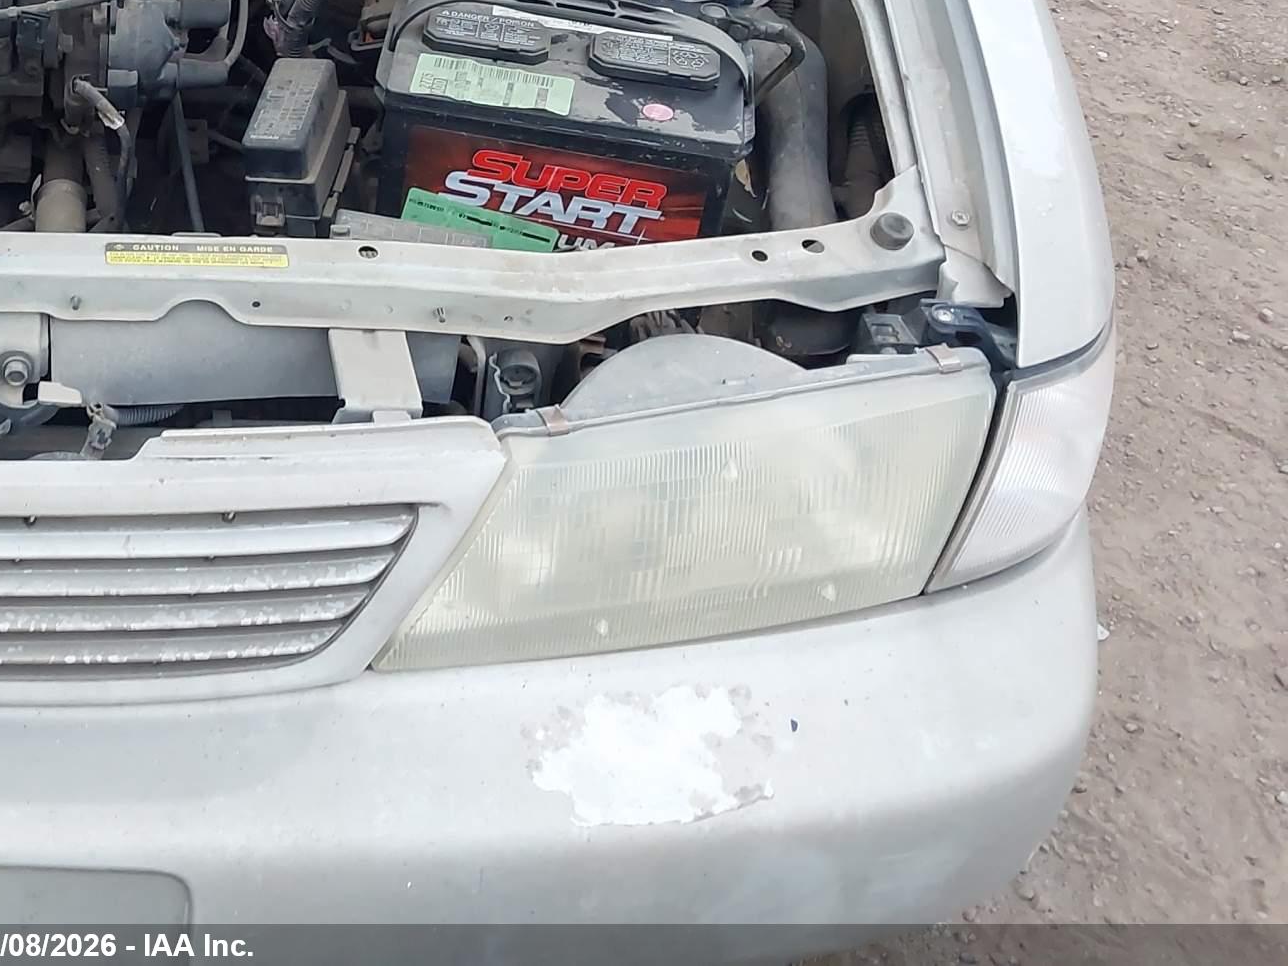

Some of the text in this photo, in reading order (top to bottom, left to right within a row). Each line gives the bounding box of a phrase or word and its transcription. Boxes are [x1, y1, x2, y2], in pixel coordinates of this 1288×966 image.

[449, 11, 490, 23] DANGER
[467, 149, 667, 210] SUPER
[439, 170, 663, 234] START
[132, 243, 179, 252] CAUTION
[239, 245, 274, 253] GARDE
